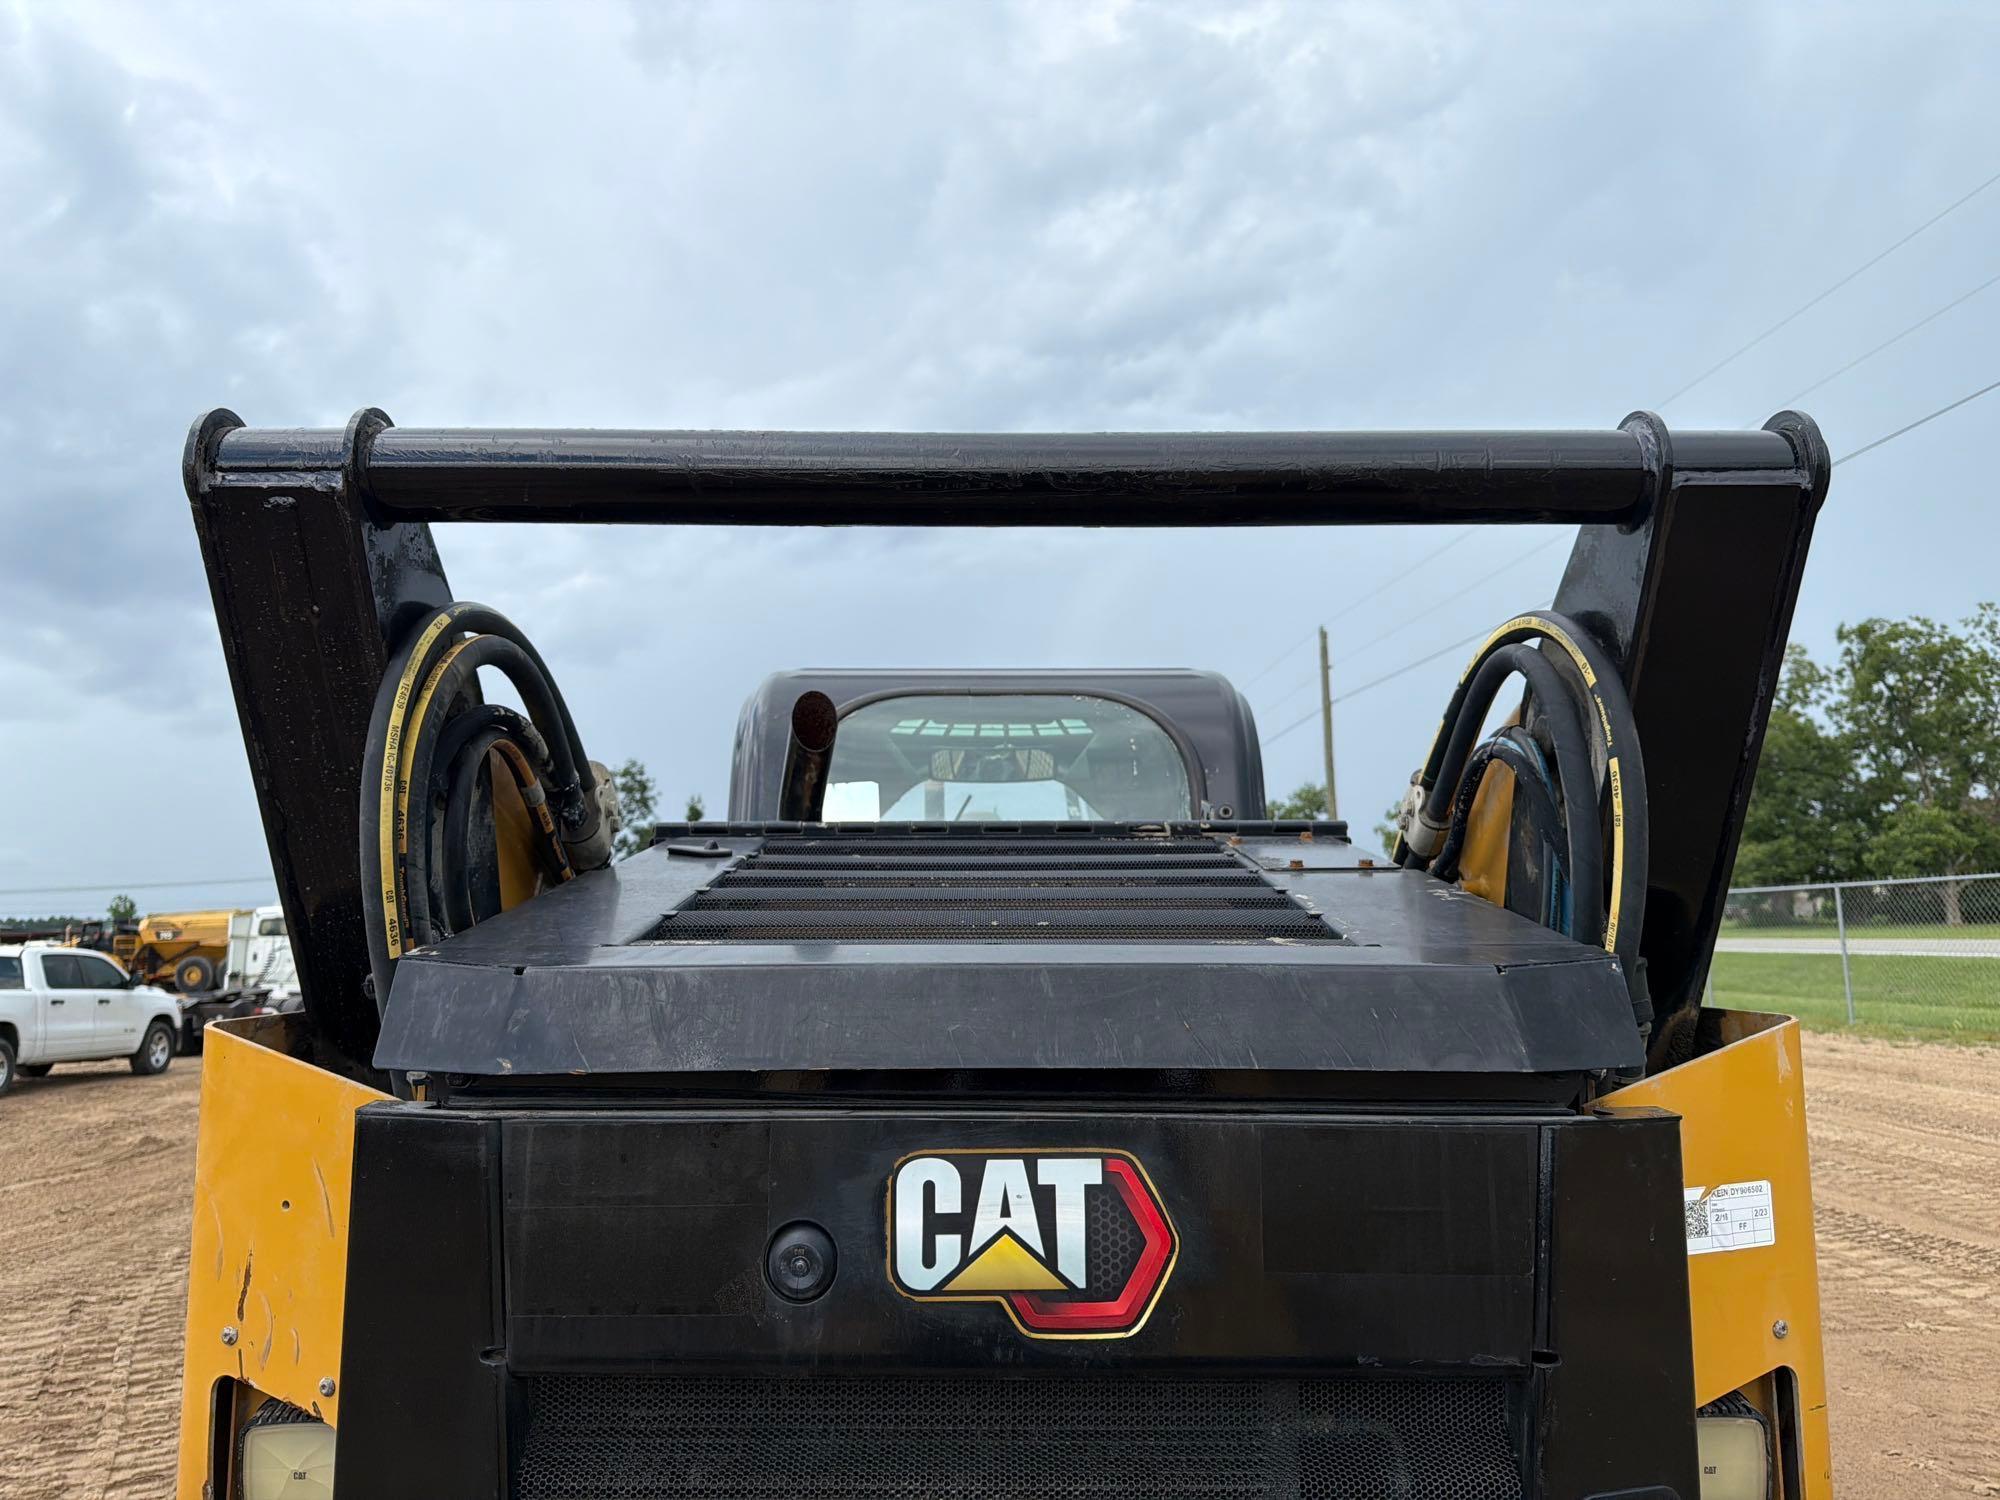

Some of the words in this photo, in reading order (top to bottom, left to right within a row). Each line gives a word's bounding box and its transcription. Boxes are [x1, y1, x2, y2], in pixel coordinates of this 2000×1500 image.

[388, 724, 400, 751] MSHA
[399, 780, 407, 794] CAT
[1611, 770, 1619, 799] 4636
[385, 890, 394, 904] CAT
[388, 918, 399, 946] 4636
[896, 1157, 1102, 1291] CAT
[293, 1471, 307, 1480] CAT
[1703, 1466, 1717, 1475] CAT
